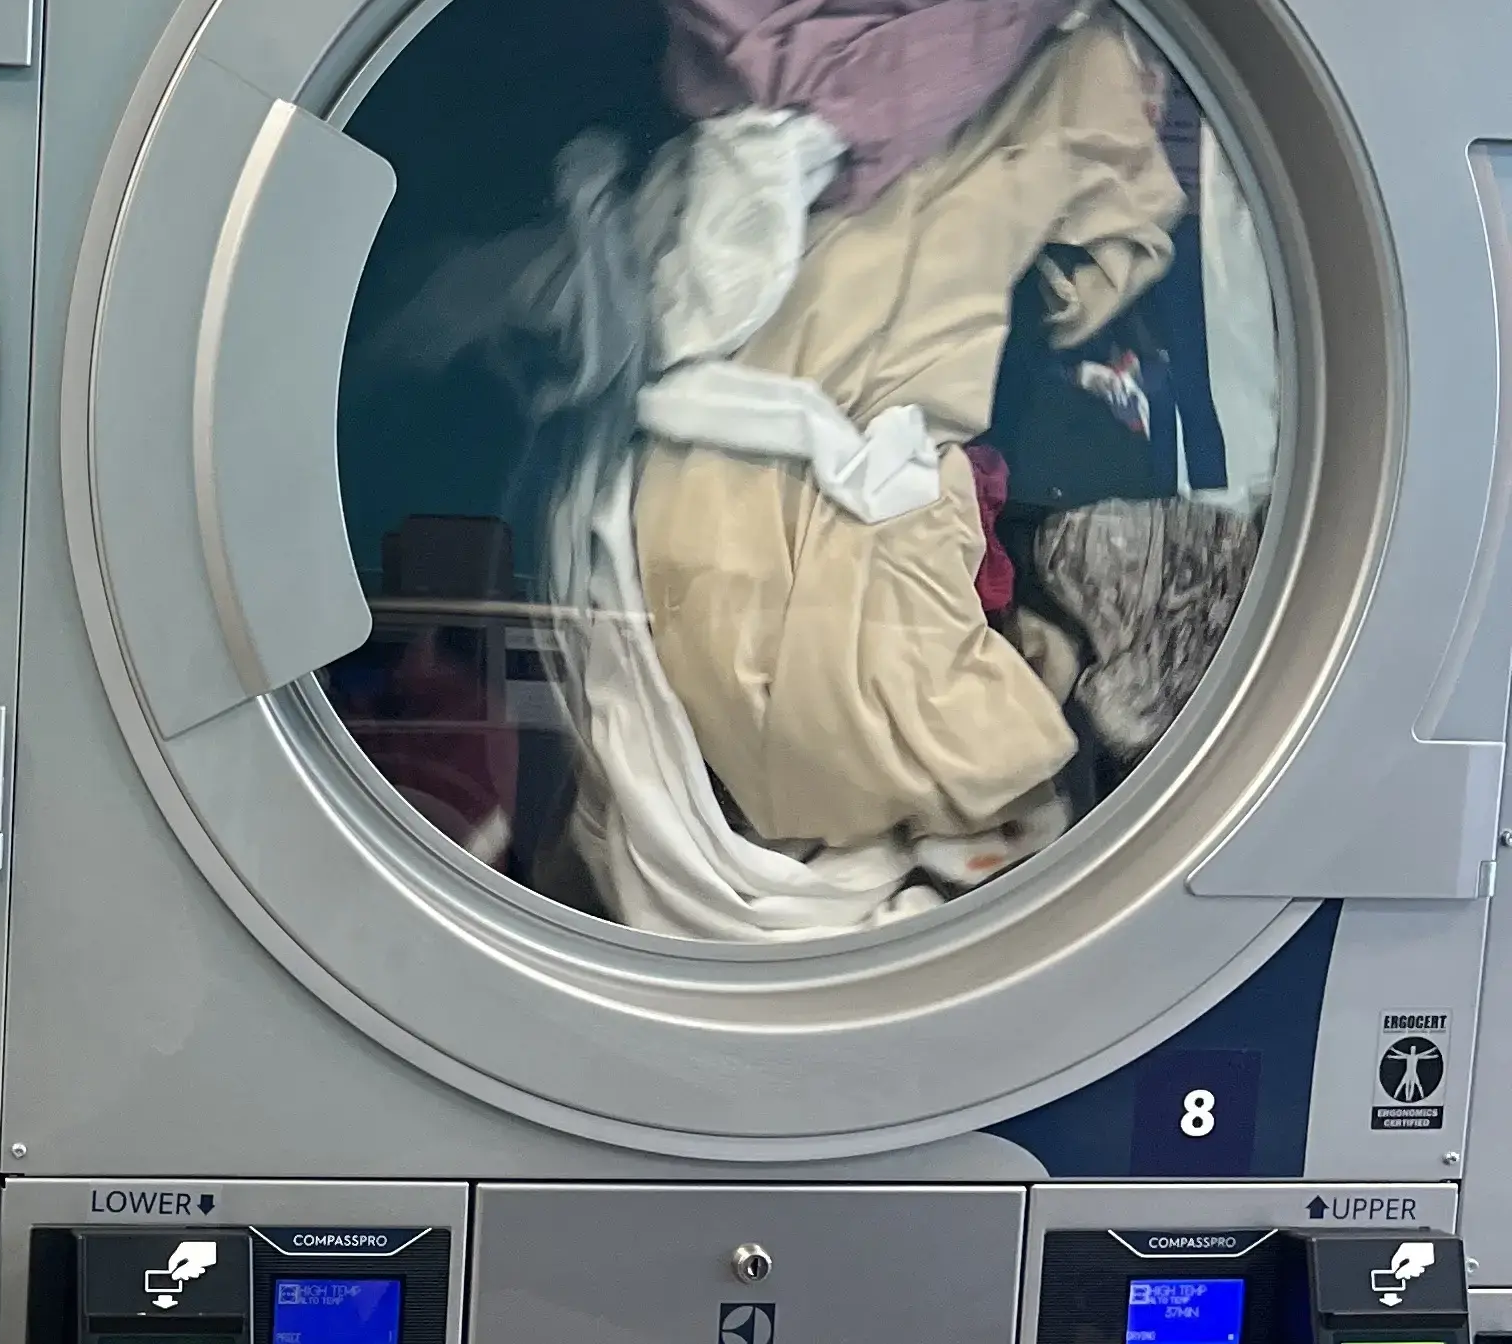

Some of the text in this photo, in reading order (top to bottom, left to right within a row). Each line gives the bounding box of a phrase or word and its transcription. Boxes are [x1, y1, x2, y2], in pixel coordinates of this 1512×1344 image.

[1383, 1015, 1447, 1029] ERGOCERT
[1180, 1089, 1215, 1137] 8
[1377, 1108, 1438, 1118] ERGONOMICS
[1383, 1118, 1430, 1127] CERTIFIED
[91, 1190, 192, 1215] LOWER
[1333, 1198, 1416, 1220] UPPER
[293, 1233, 387, 1247] COMPASSPRO
[1149, 1236, 1236, 1249] COMPASSPRO
